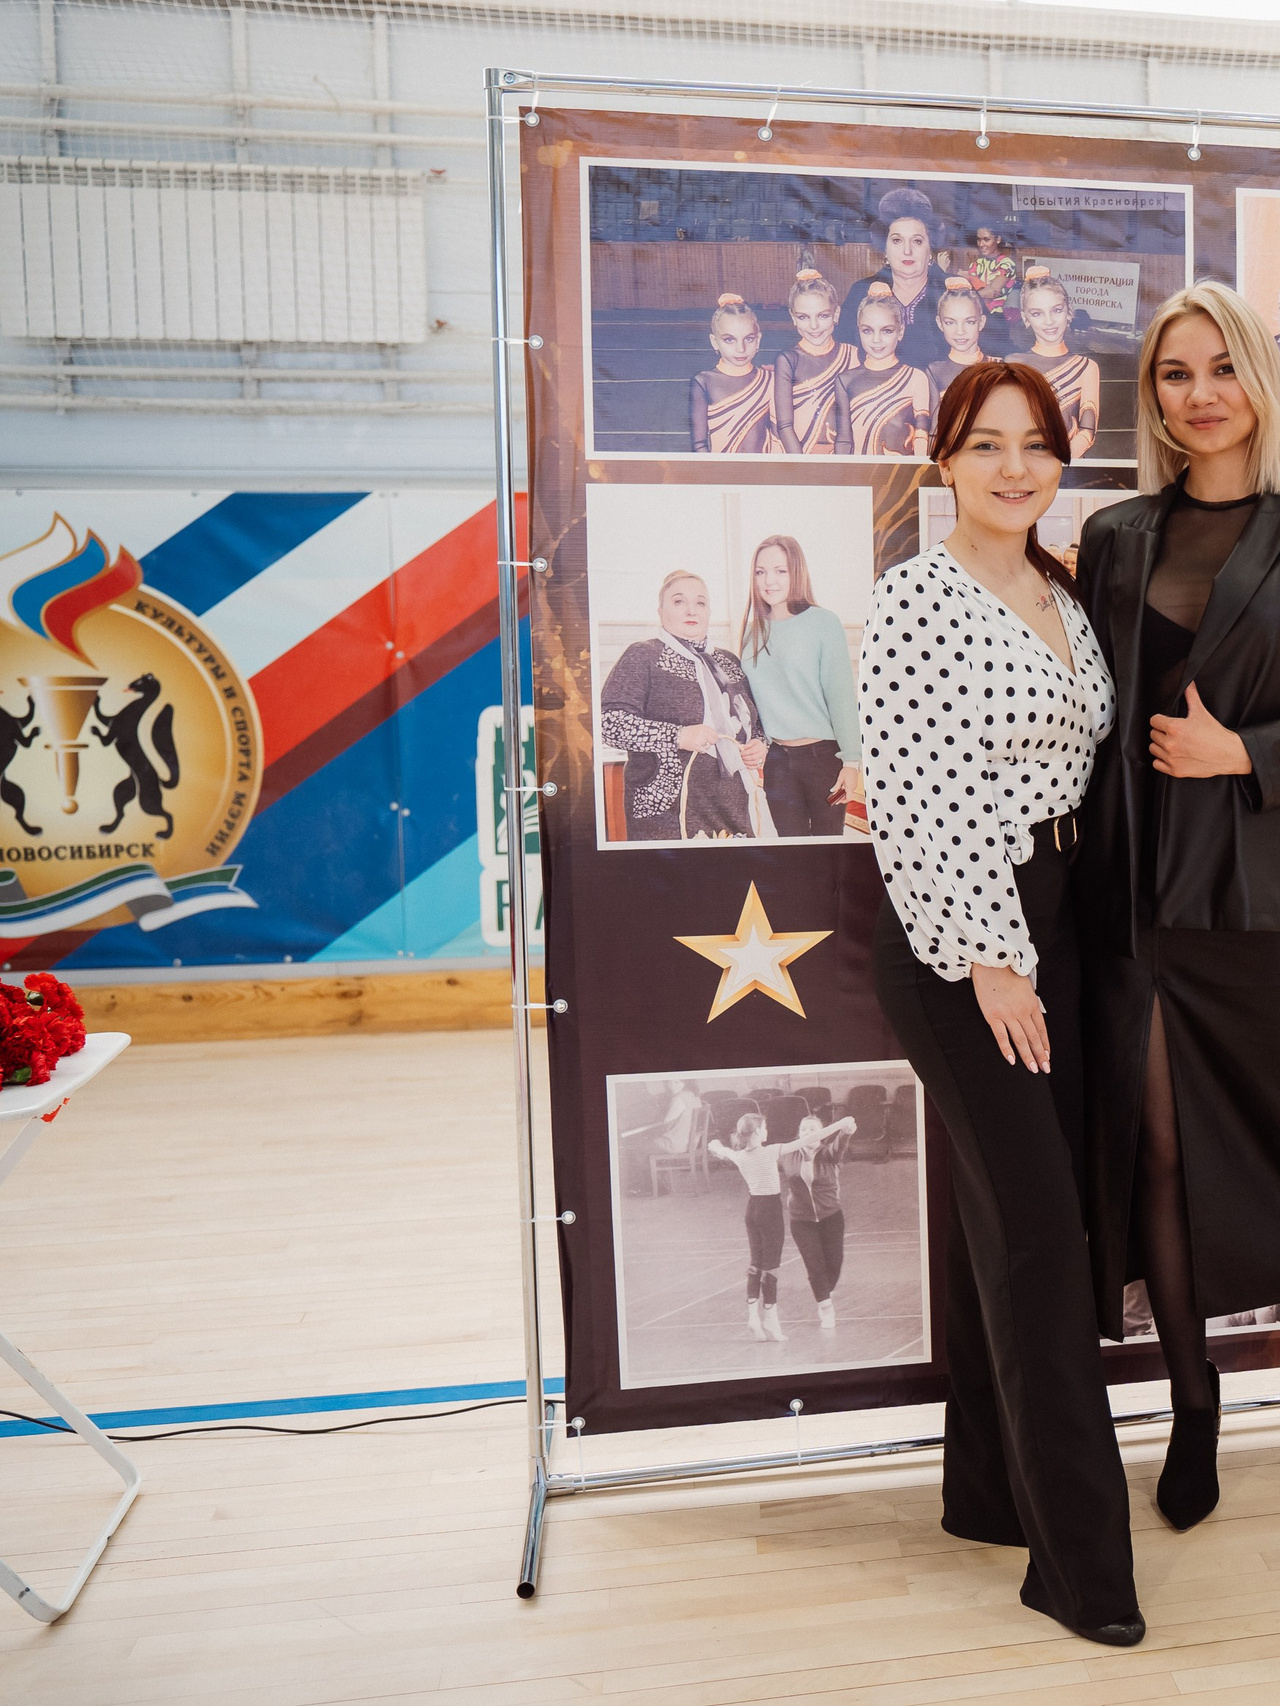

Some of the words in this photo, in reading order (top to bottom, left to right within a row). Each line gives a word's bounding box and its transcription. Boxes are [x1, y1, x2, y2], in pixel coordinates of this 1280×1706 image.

[1057, 273, 1134, 287] АДМИНИСТРАЦИЯ
[1075, 286, 1110, 297] ГОРОДА
[134, 600, 227, 681] КУЛЬТУРЫ
[230, 705, 252, 782] СПОРТА
[205, 790, 247, 858] МЭРИИ
